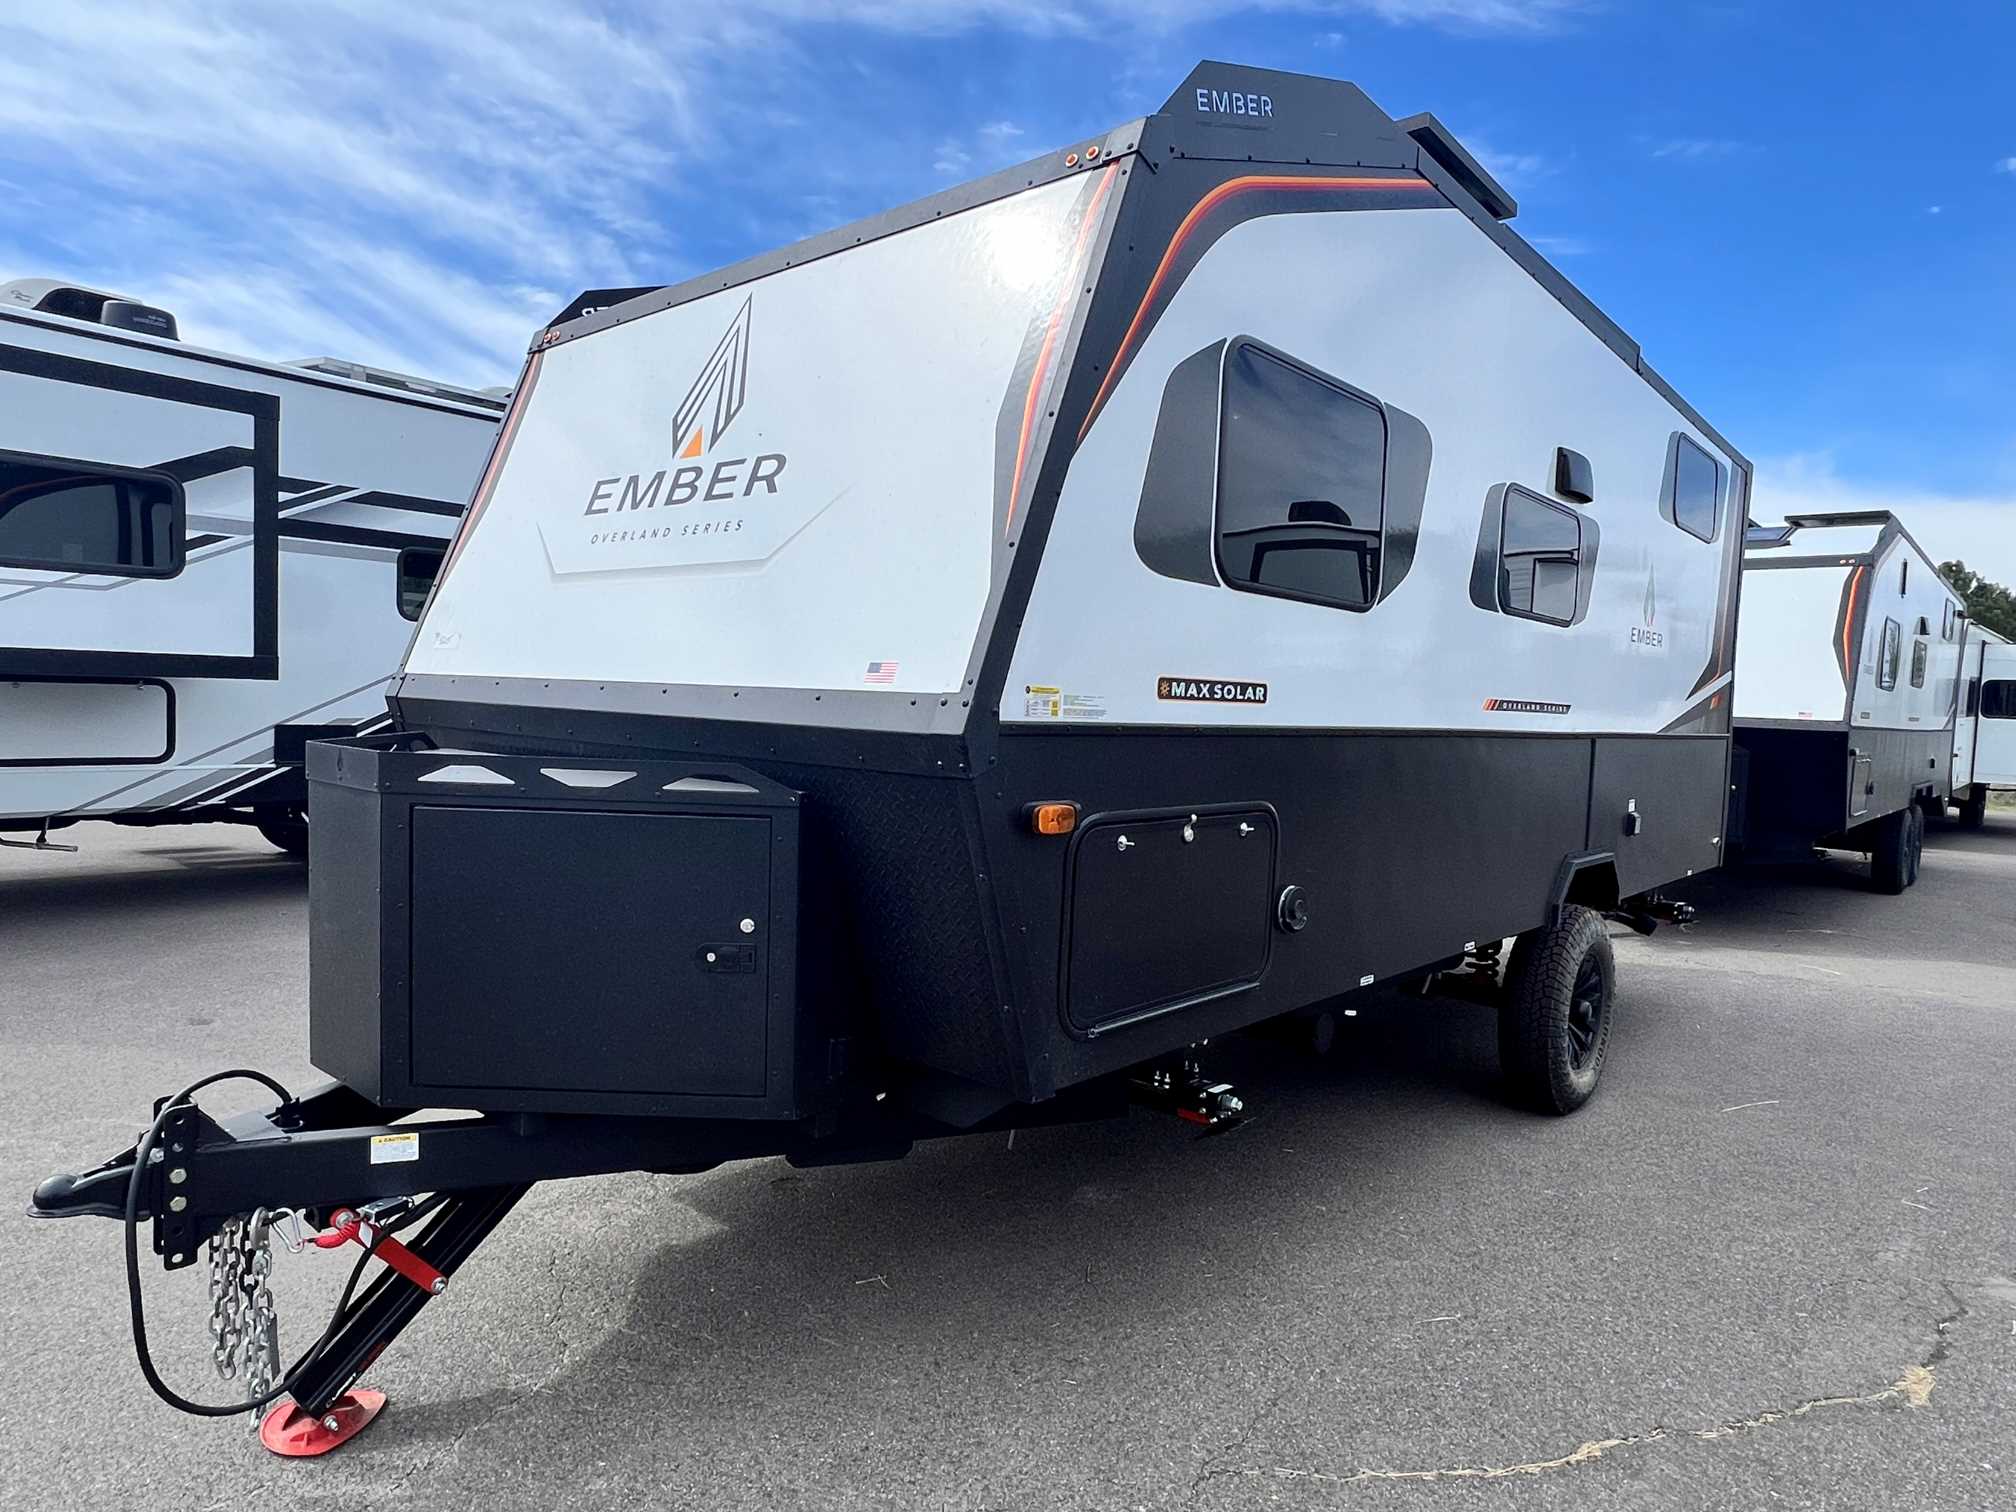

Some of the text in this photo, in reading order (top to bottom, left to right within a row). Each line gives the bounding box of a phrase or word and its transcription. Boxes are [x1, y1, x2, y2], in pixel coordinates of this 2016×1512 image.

[1196, 88, 1273, 118] EMBER
[584, 453, 787, 516] EMBER
[591, 519, 744, 545] OVERLAND SERIES
[1631, 627, 1663, 648] EMBER
[1171, 681, 1265, 700] MAX SOLAR
